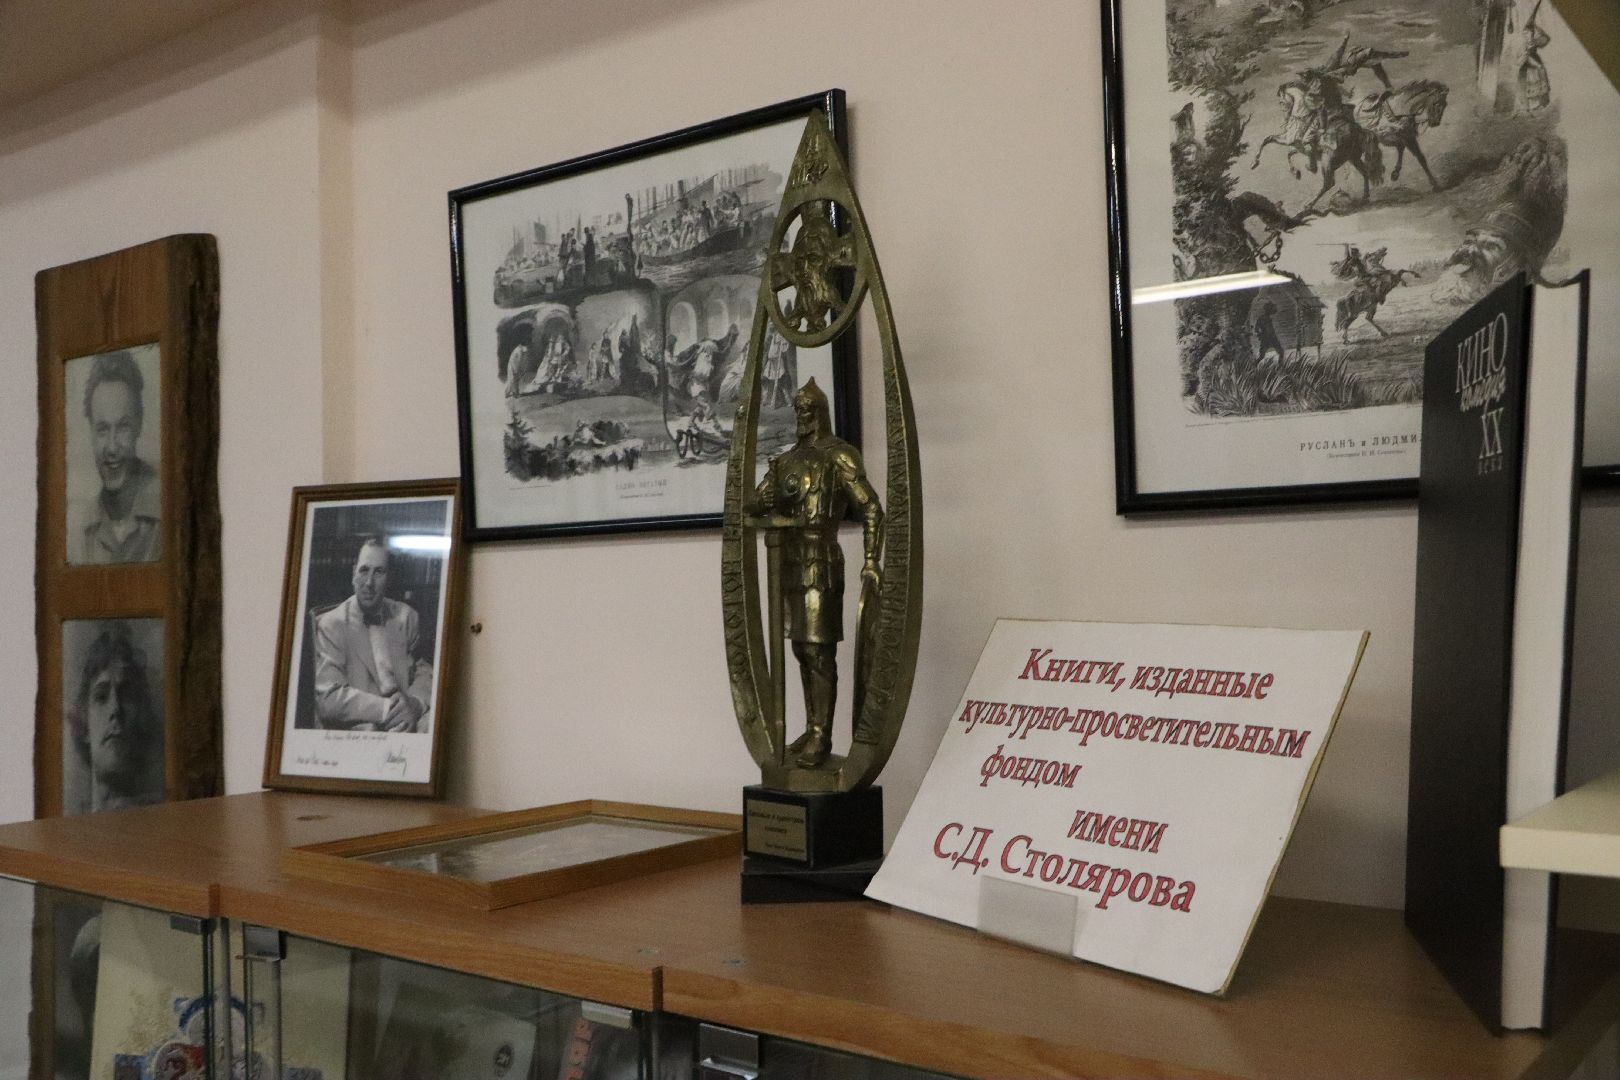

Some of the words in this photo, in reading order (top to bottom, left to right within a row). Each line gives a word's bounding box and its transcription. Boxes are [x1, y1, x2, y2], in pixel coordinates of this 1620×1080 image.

[1456, 312, 1508, 393] КИНО
[1300, 439, 1356, 452] РУСЛАНЪ
[1372, 434, 1421, 446] ЛЮДМИ
[1018, 648, 1125, 693] Книги,
[1131, 662, 1274, 700] изданные
[959, 700, 1311, 758] культурно-просветительным
[980, 745, 1082, 788] фондом
[1067, 809, 1169, 853] имени
[933, 822, 993, 875] С.Д.
[1000, 835, 1197, 912] Столярова
